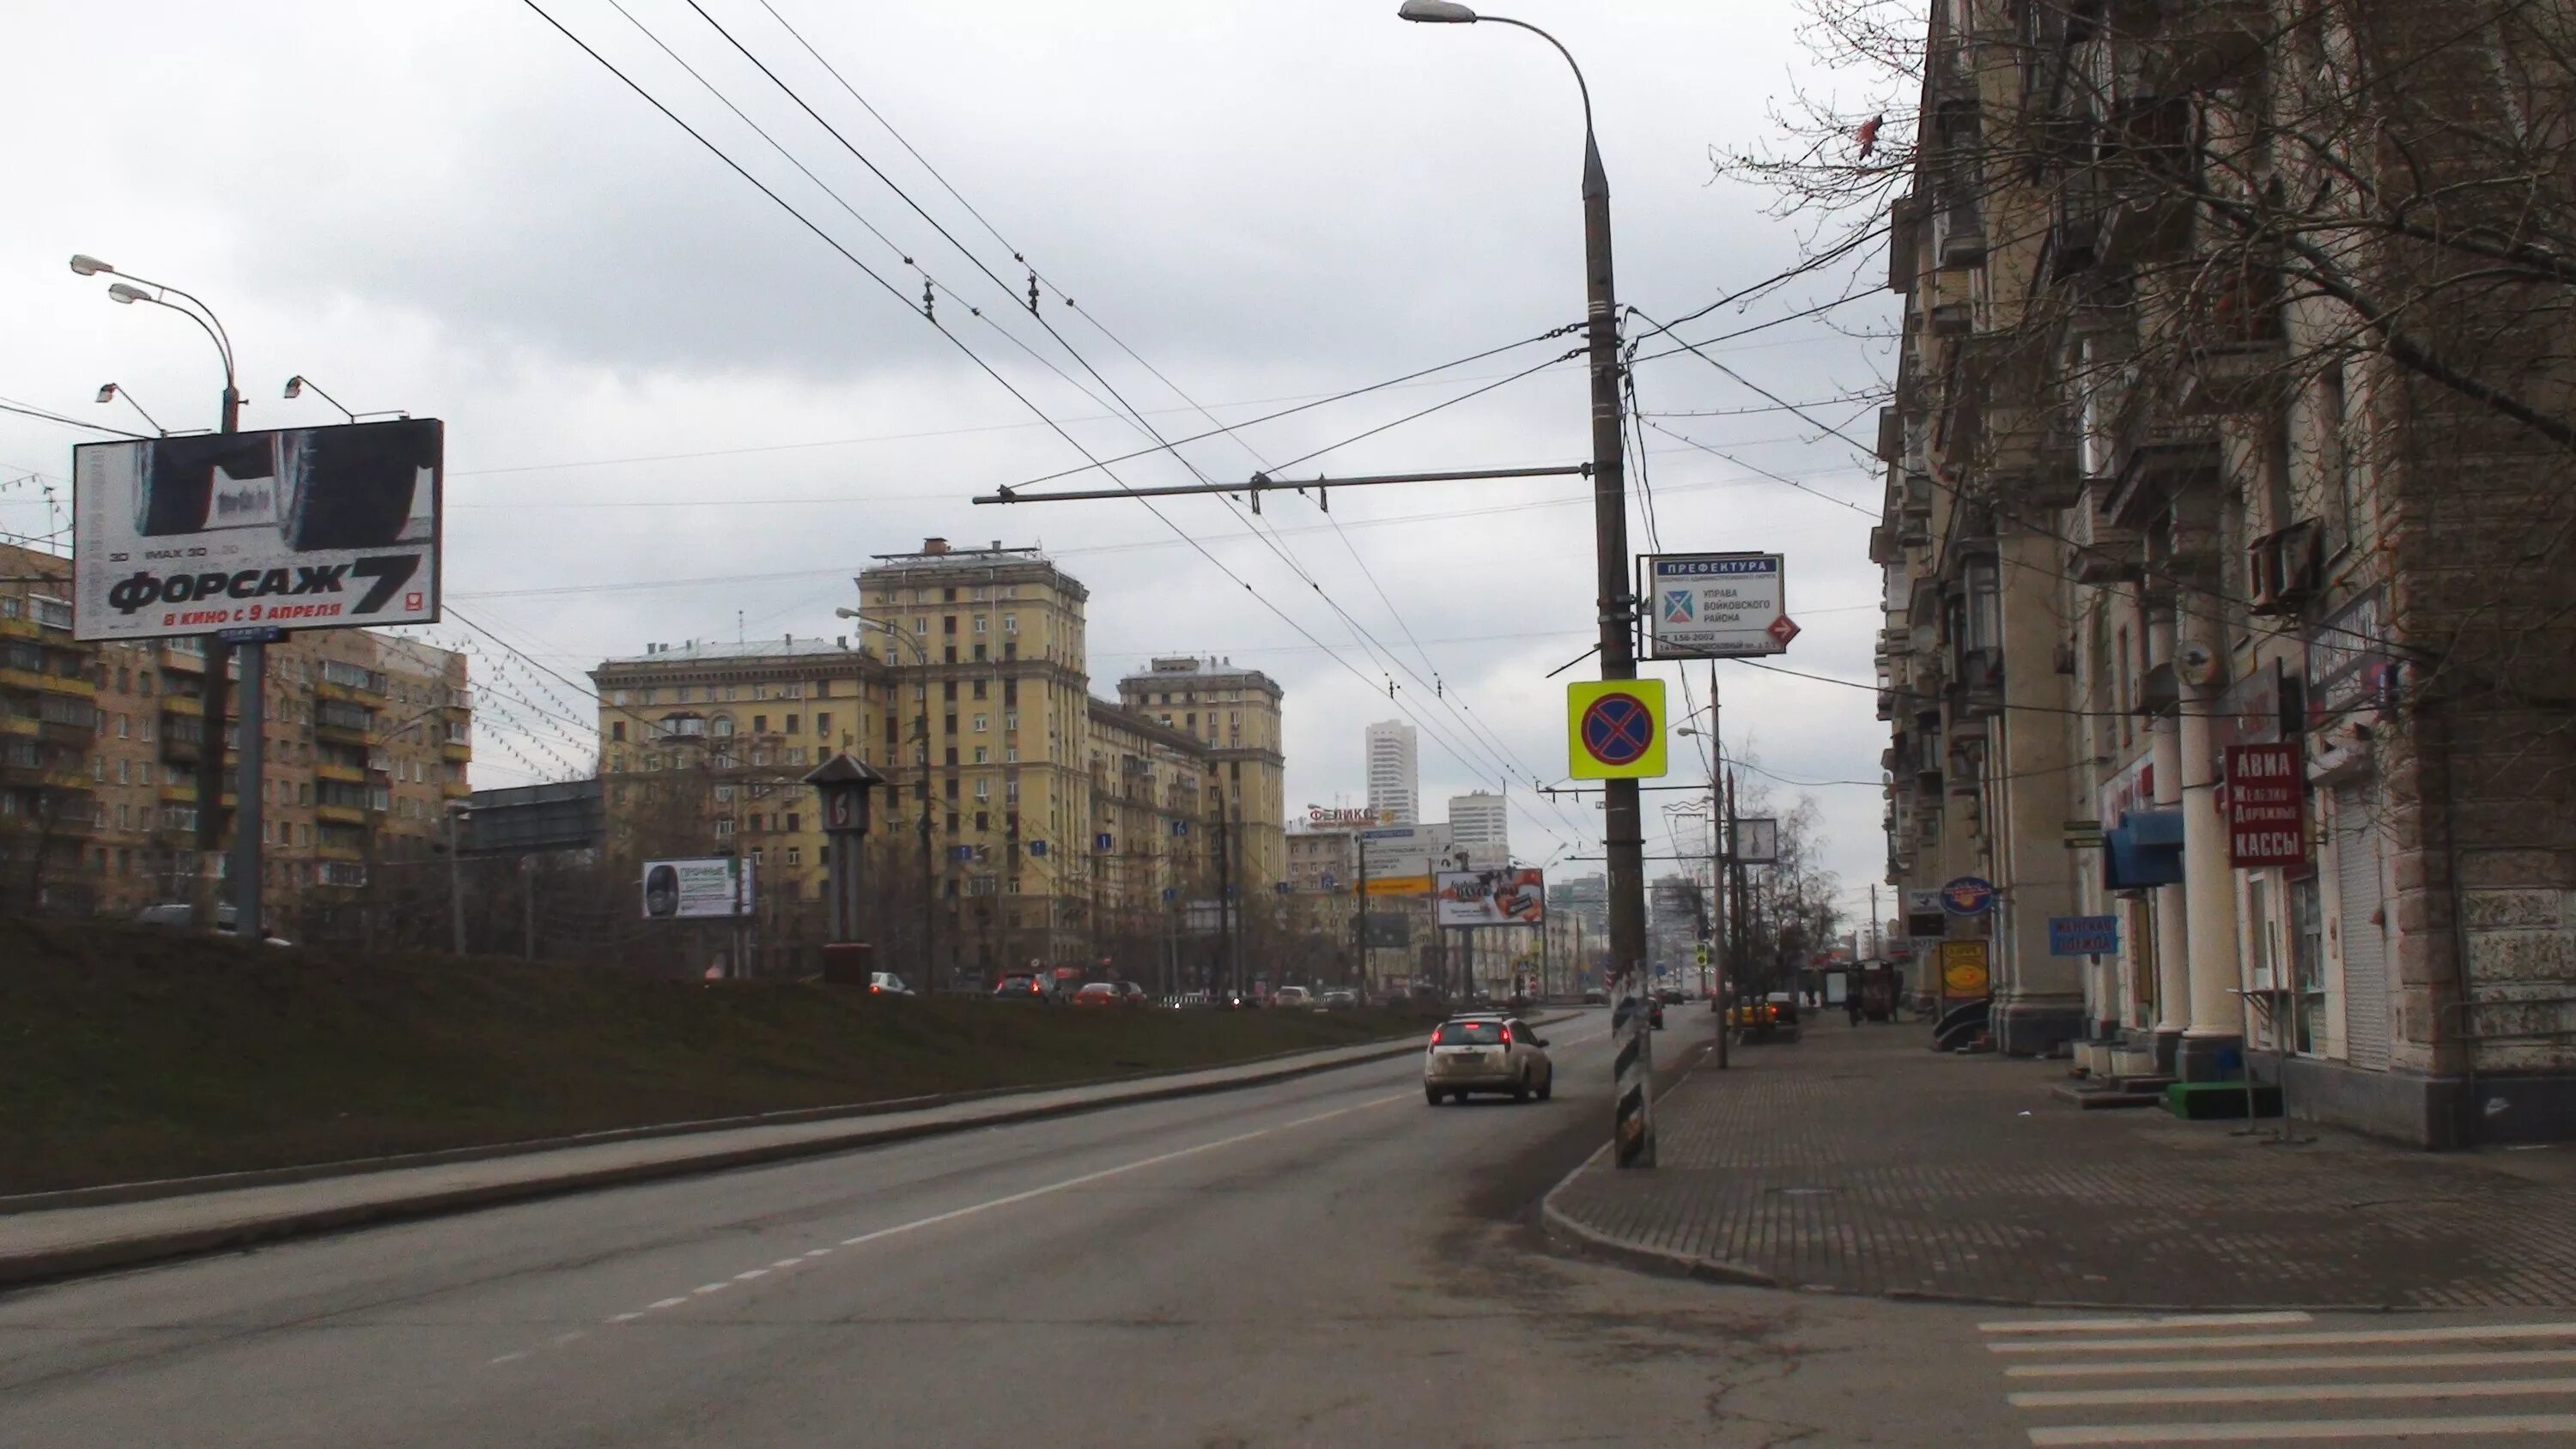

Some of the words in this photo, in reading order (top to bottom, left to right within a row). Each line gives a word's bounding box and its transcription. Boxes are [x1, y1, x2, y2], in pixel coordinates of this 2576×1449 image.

[1668, 561, 1767, 573] ПРЕФЕКТУРА
[108, 565, 351, 615] ФОРСАЖ
[351, 554, 422, 615] 7
[1703, 589, 1738, 598] УПРАВА
[1704, 599, 1771, 611] ВОЙКОВСКОГО
[163, 613, 175, 626] В
[179, 609, 227, 625] КИНО
[249, 603, 261, 621] 9
[268, 603, 342, 619] АПРЕЛЯ
[1704, 612, 1740, 623] РАЙОНА
[2238, 752, 2290, 777] АВИА
[2236, 831, 2299, 857] КАССЫ
